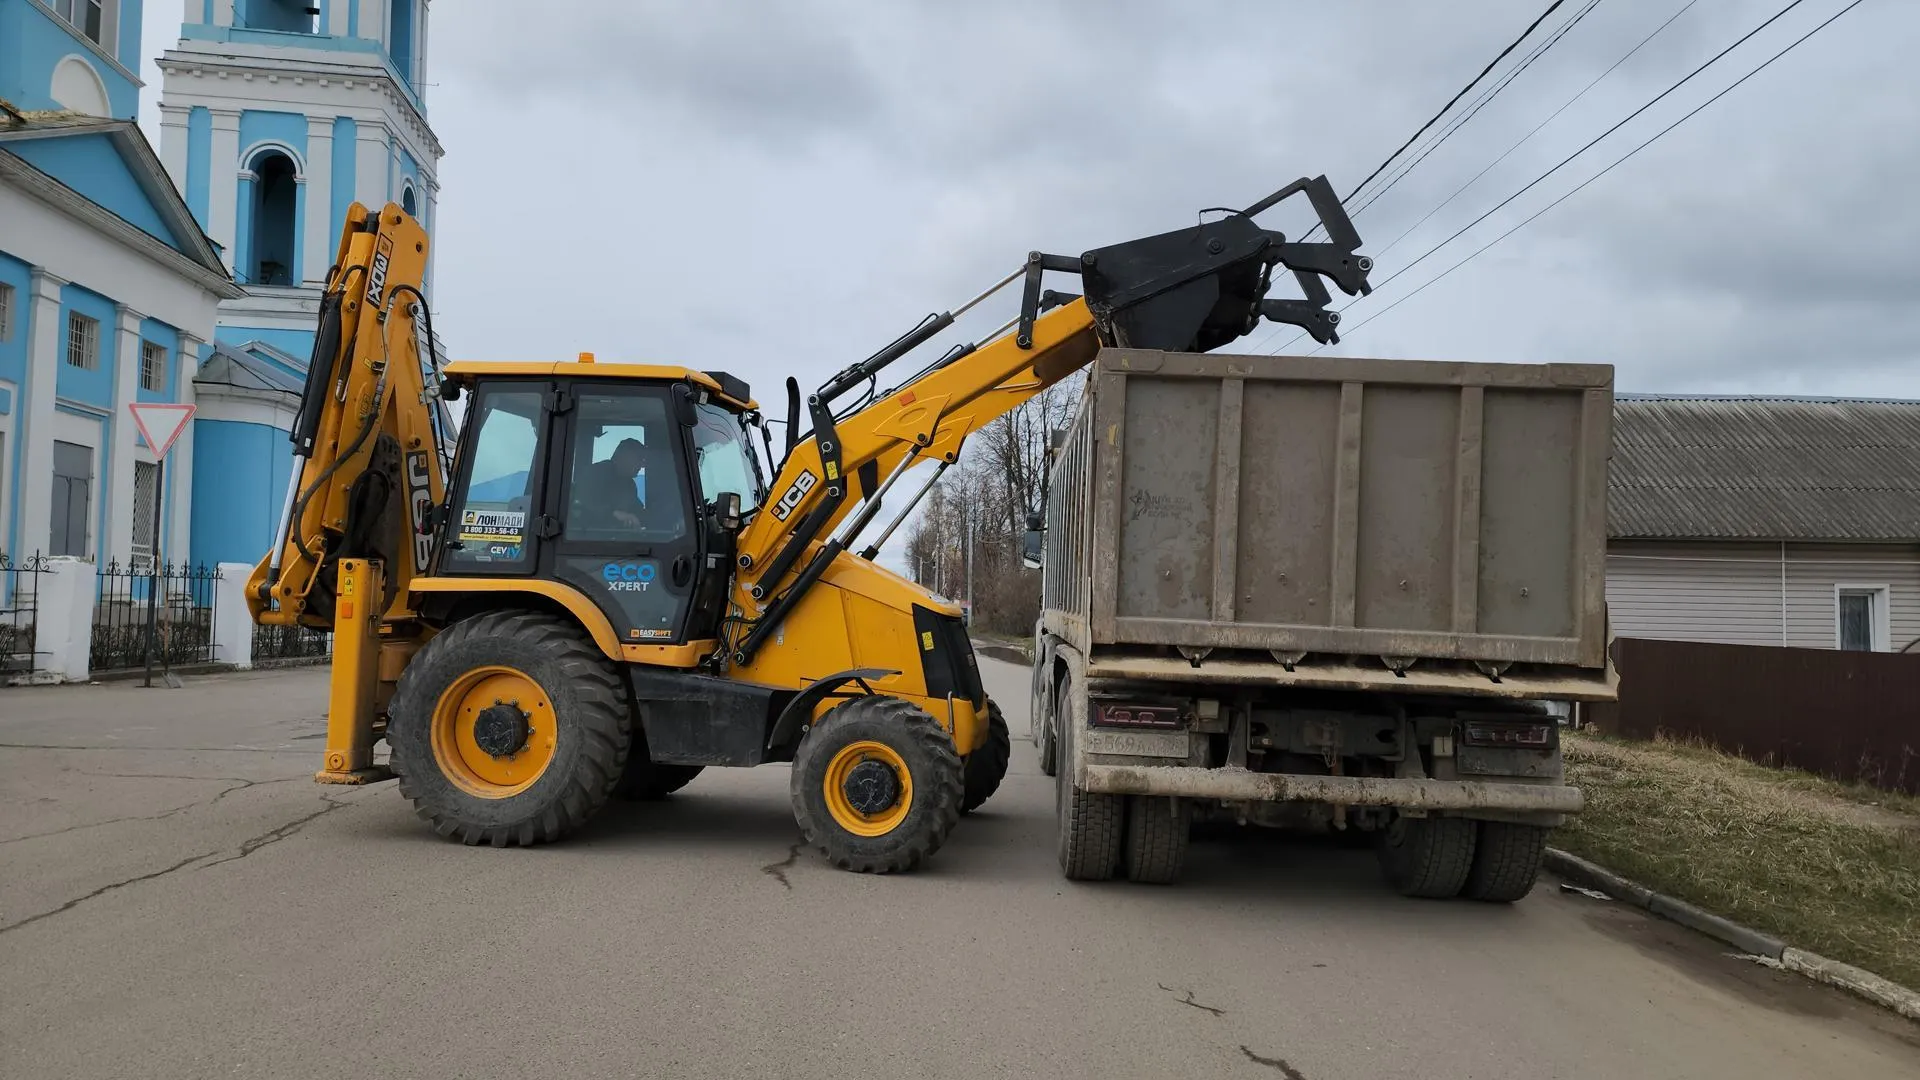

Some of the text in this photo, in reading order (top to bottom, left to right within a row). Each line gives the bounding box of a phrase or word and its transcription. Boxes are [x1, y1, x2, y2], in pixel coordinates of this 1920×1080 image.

[777, 471, 816, 521] JCB
[477, 515, 522, 527] ЛОНМАДИ
[470, 526, 483, 534] 800
[603, 563, 656, 581] eco
[608, 581, 649, 592] XPERT
